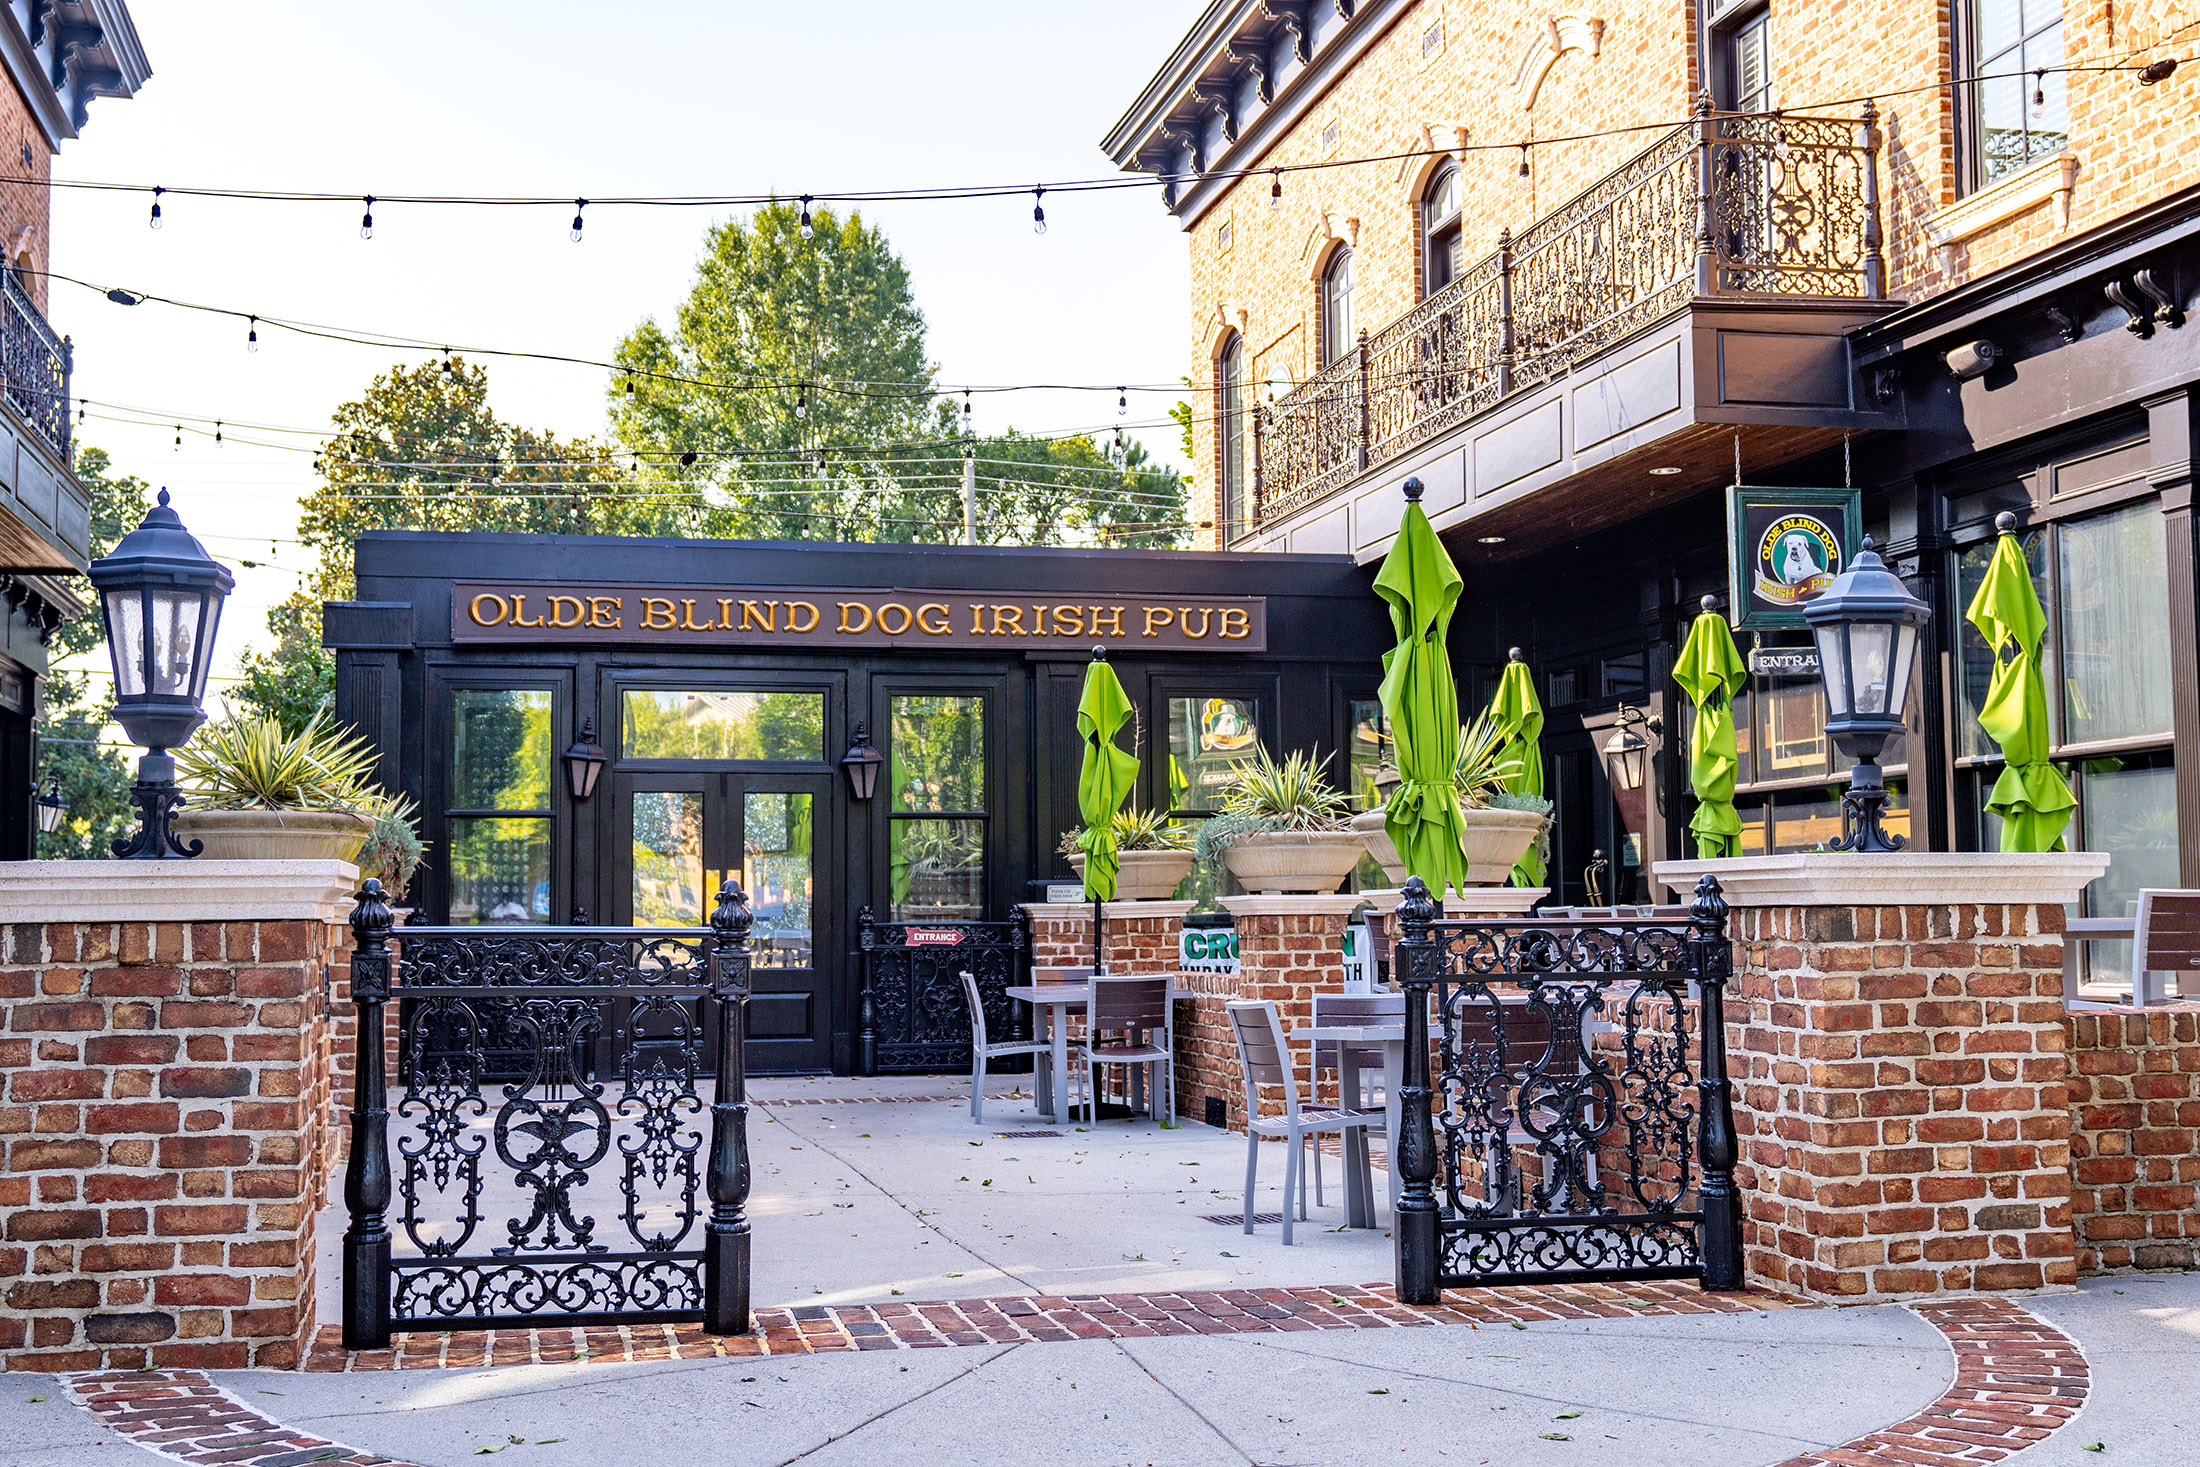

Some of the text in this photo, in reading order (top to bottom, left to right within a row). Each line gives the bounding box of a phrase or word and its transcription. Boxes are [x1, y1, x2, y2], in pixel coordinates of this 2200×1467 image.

[1762, 518, 1837, 560] OLDE BLIND DOG
[1759, 577, 1833, 598] IRISH PU
[468, 593, 1252, 640] OLDE BLIND DOG IRISH PUB
[913, 932, 957, 942] ENTRANCE
